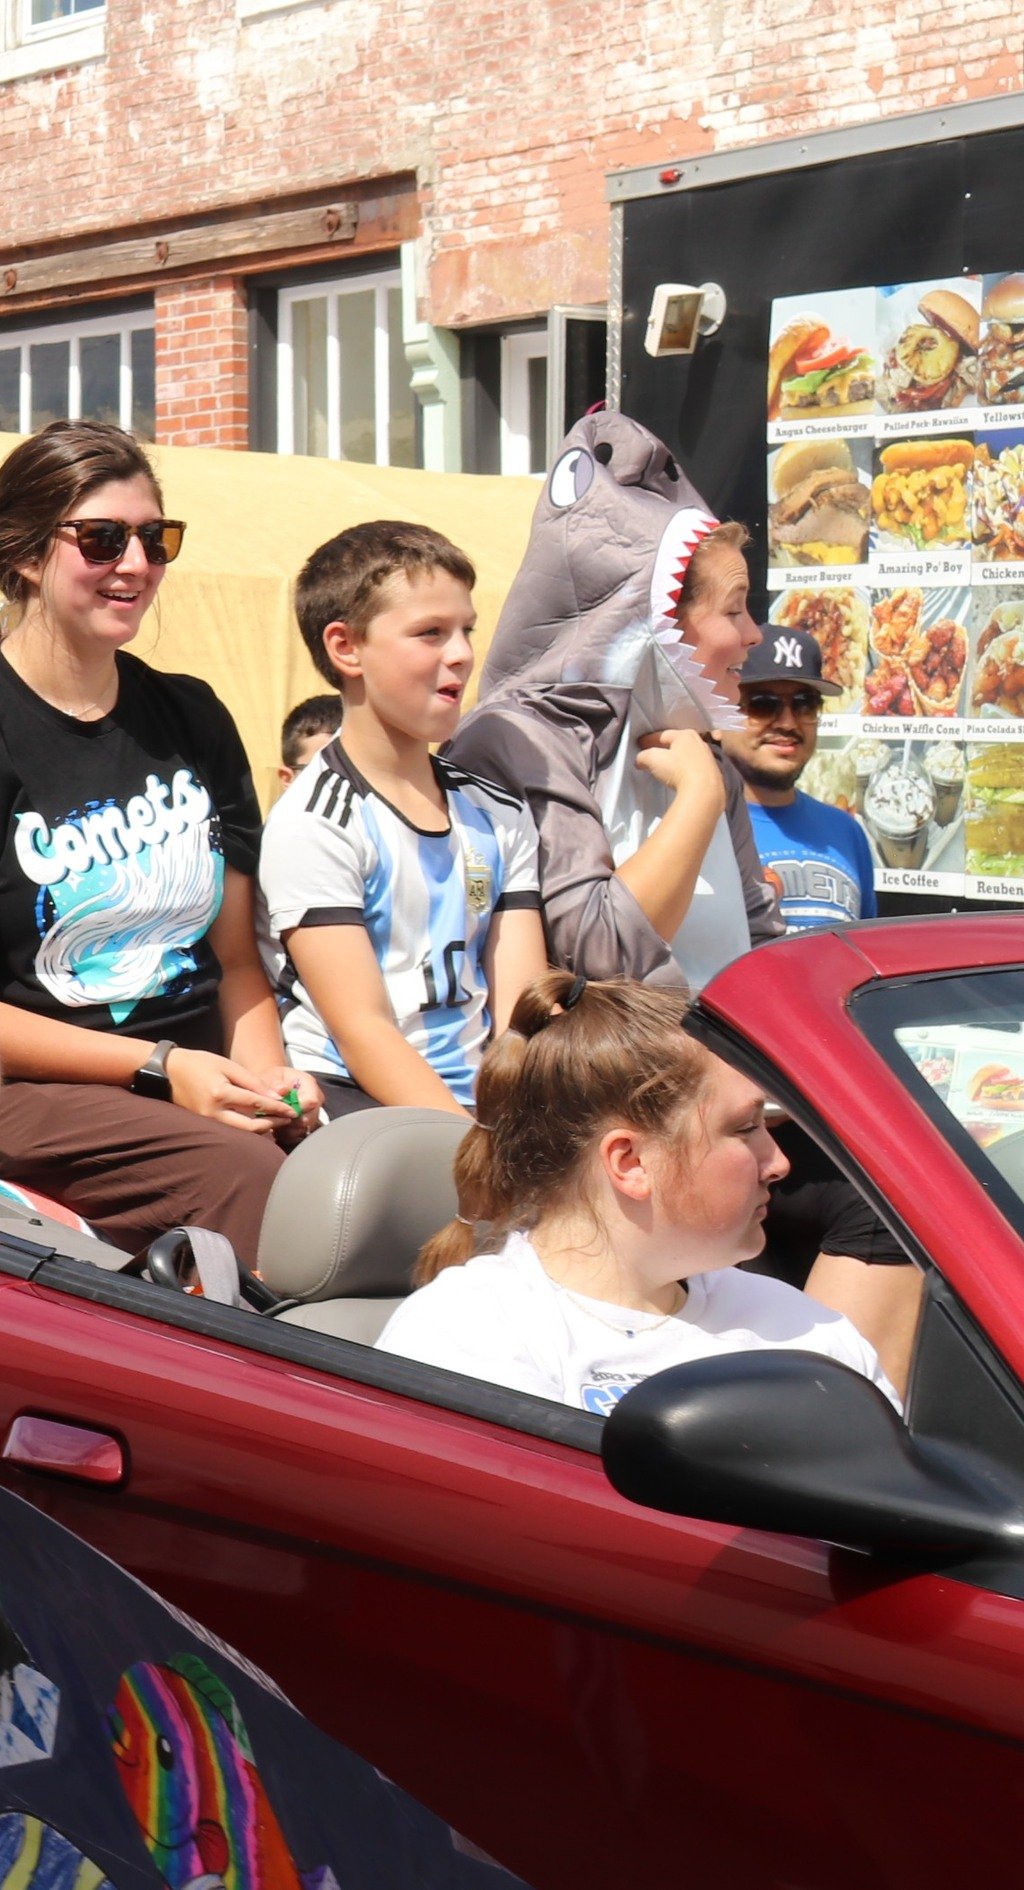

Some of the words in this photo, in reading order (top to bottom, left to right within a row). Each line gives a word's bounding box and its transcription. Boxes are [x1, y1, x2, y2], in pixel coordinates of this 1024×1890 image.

[776, 428, 803, 437] Angus
[805, 423, 867, 434] Cheeseburger
[878, 563, 923, 576] Amazing
[943, 561, 963, 573] Boy
[785, 573, 817, 583] Ranger
[820, 571, 852, 582] Burger
[773, 635, 804, 669] NY
[862, 723, 900, 733] Chicken
[902, 723, 933, 734] Waffle
[935, 724, 960, 735] Cone
[987, 725, 1016, 734] Colada
[14, 768, 212, 886] Comets
[882, 873, 900, 885] Ice
[902, 874, 939, 887] Coffee
[977, 881, 1024, 896] Reuben
